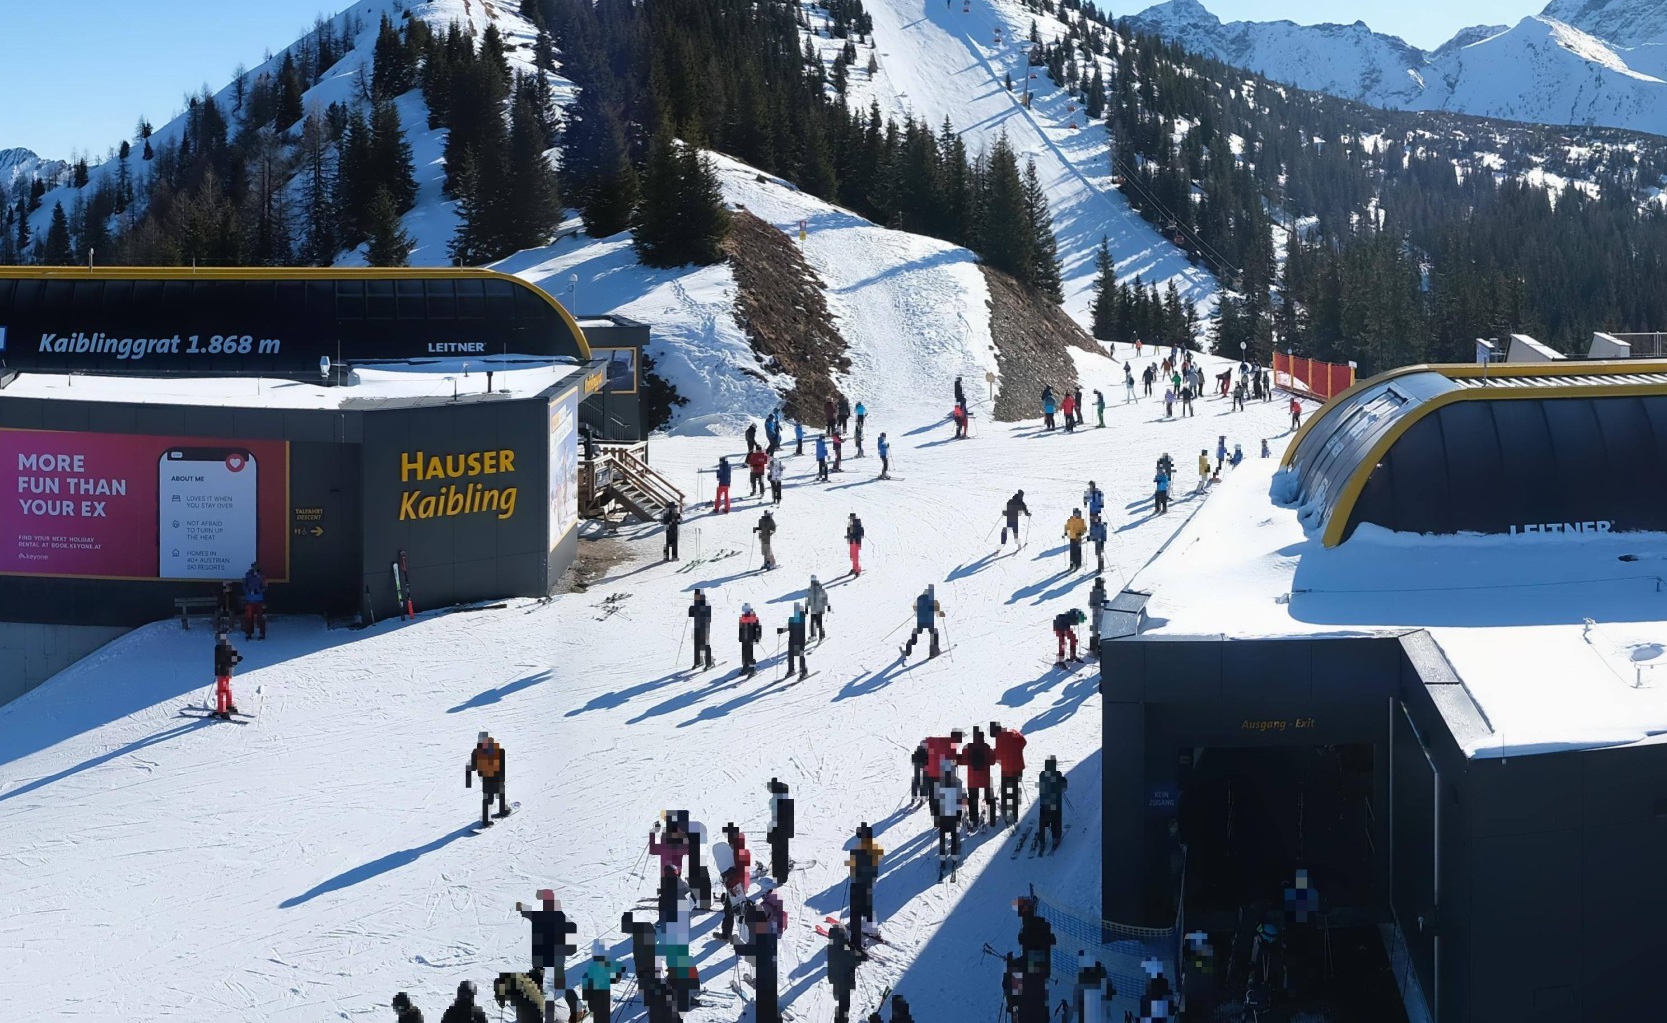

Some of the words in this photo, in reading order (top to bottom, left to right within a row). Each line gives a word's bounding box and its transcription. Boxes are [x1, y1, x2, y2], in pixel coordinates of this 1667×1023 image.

[38, 332, 181, 360] Kaiblinggrat
[185, 335, 252, 354] 1.868
[258, 336, 281, 354] m
[427, 342, 485, 353] LEITNER
[18, 453, 85, 472] MORE
[401, 449, 516, 482] HAUSER
[18, 477, 60, 495] FUN
[66, 478, 127, 496] THAN
[19, 499, 75, 516] YOUR
[81, 501, 107, 517] EX
[399, 483, 518, 521] Kaibling
[1242, 719, 1287, 731] Ausgang
[1295, 718, 1316, 729] Exit
